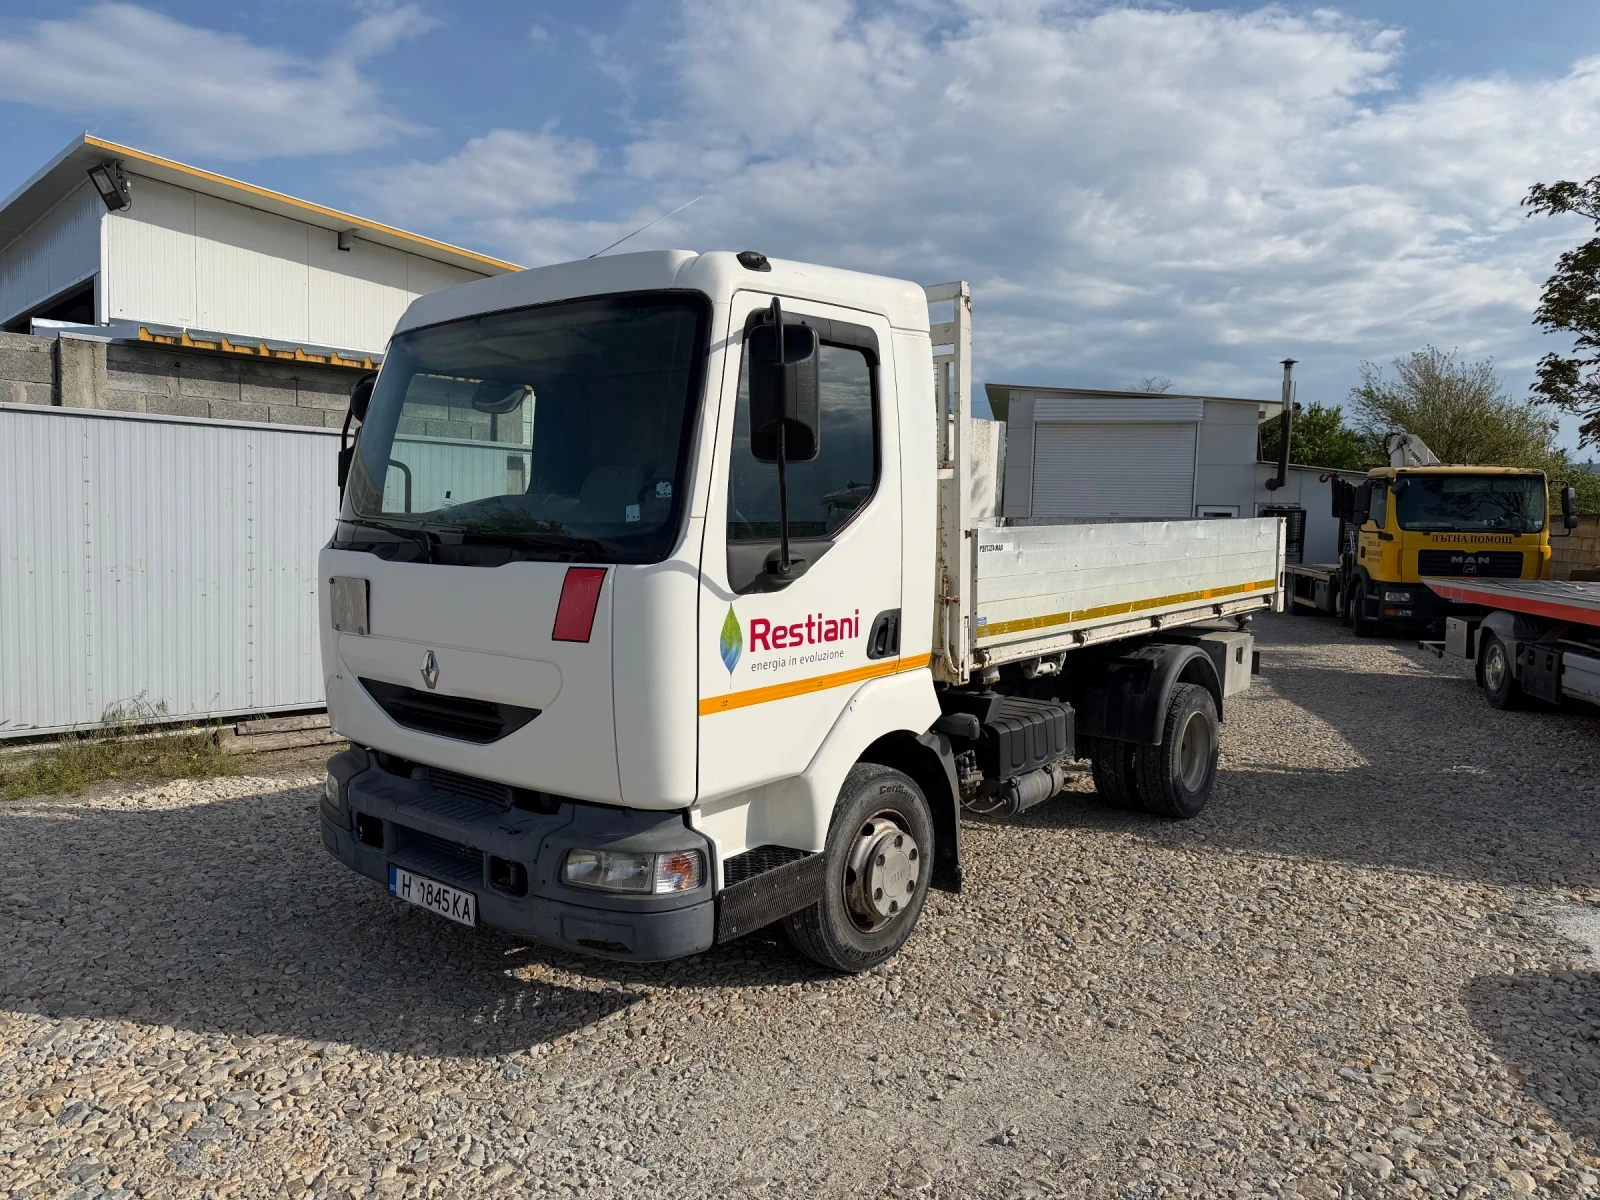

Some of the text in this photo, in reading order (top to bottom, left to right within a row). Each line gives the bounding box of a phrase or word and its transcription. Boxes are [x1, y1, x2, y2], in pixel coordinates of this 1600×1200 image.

[1432, 534, 1513, 545] ПЪТНА ПОМОЩ
[1451, 556, 1490, 564] MAN
[750, 608, 860, 653] Restiani
[751, 650, 845, 672] energia in evoluzione
